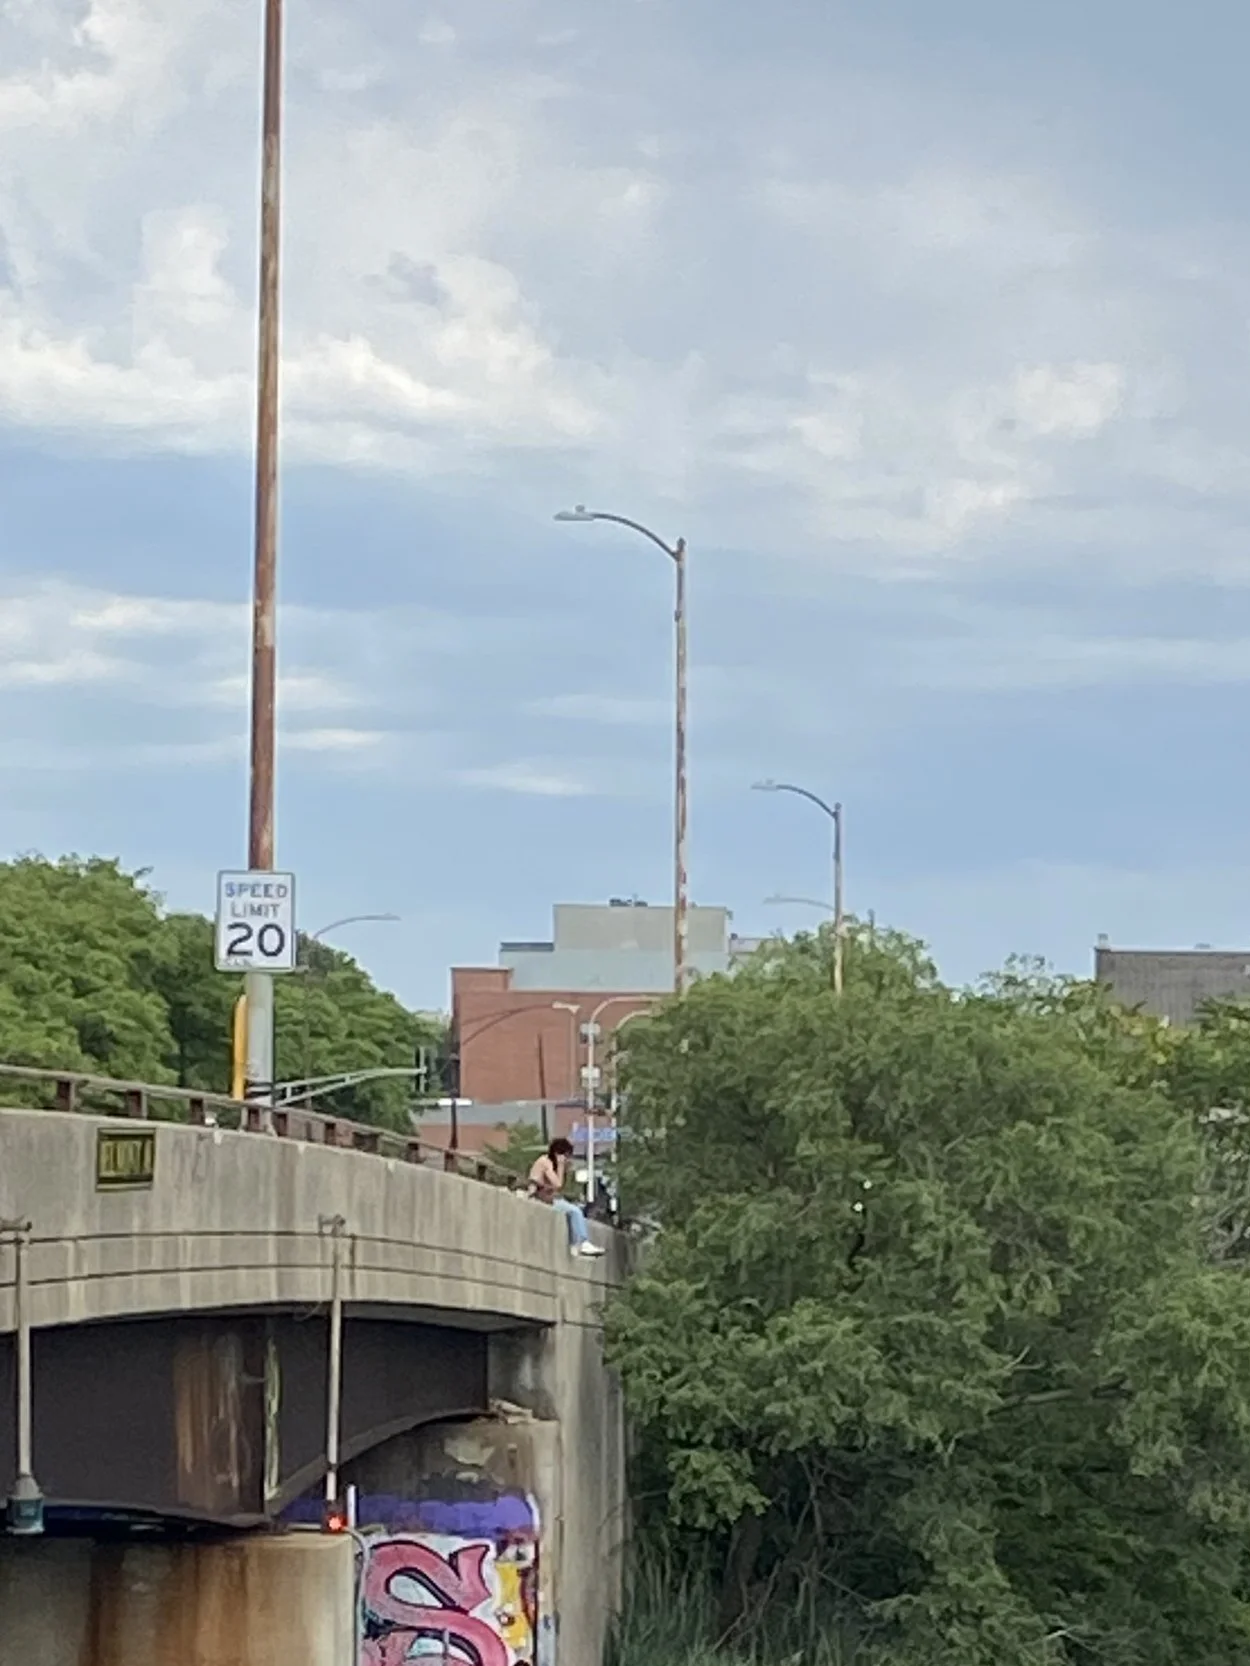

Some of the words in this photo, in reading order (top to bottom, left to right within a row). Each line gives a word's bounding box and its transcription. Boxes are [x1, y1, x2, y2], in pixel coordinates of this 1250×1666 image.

[225, 882, 288, 898] SPEED
[231, 902, 281, 918] LIMIT
[227, 922, 285, 957] 20
